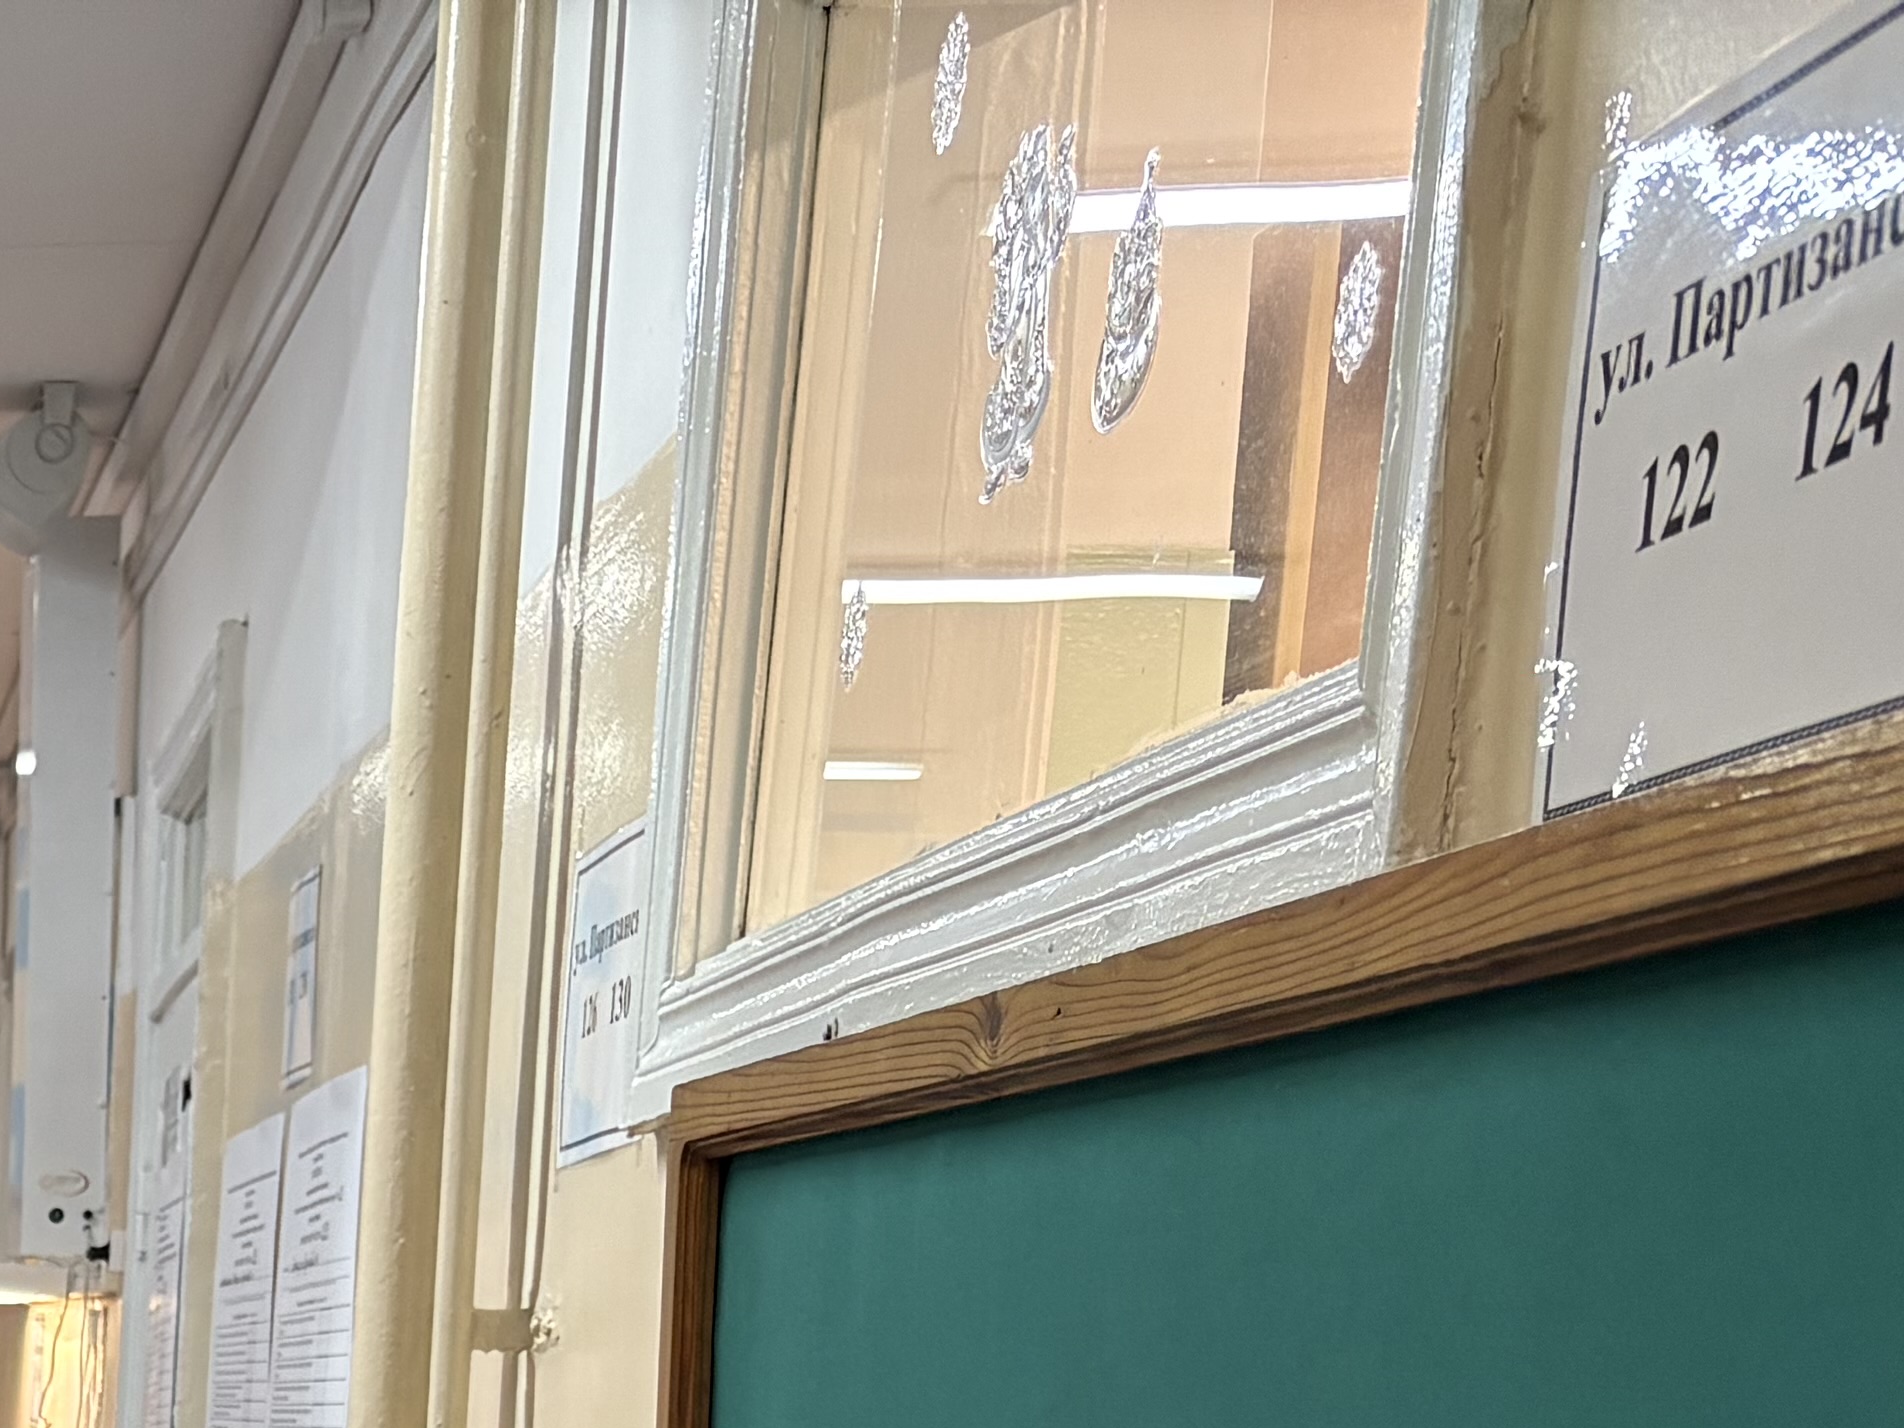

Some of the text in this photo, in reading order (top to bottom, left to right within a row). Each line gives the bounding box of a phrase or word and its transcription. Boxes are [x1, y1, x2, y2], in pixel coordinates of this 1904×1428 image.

[1594, 330, 1653, 425] ул.
[1635, 340, 1894, 553] 122 124
[610, 976, 632, 1025] 130
